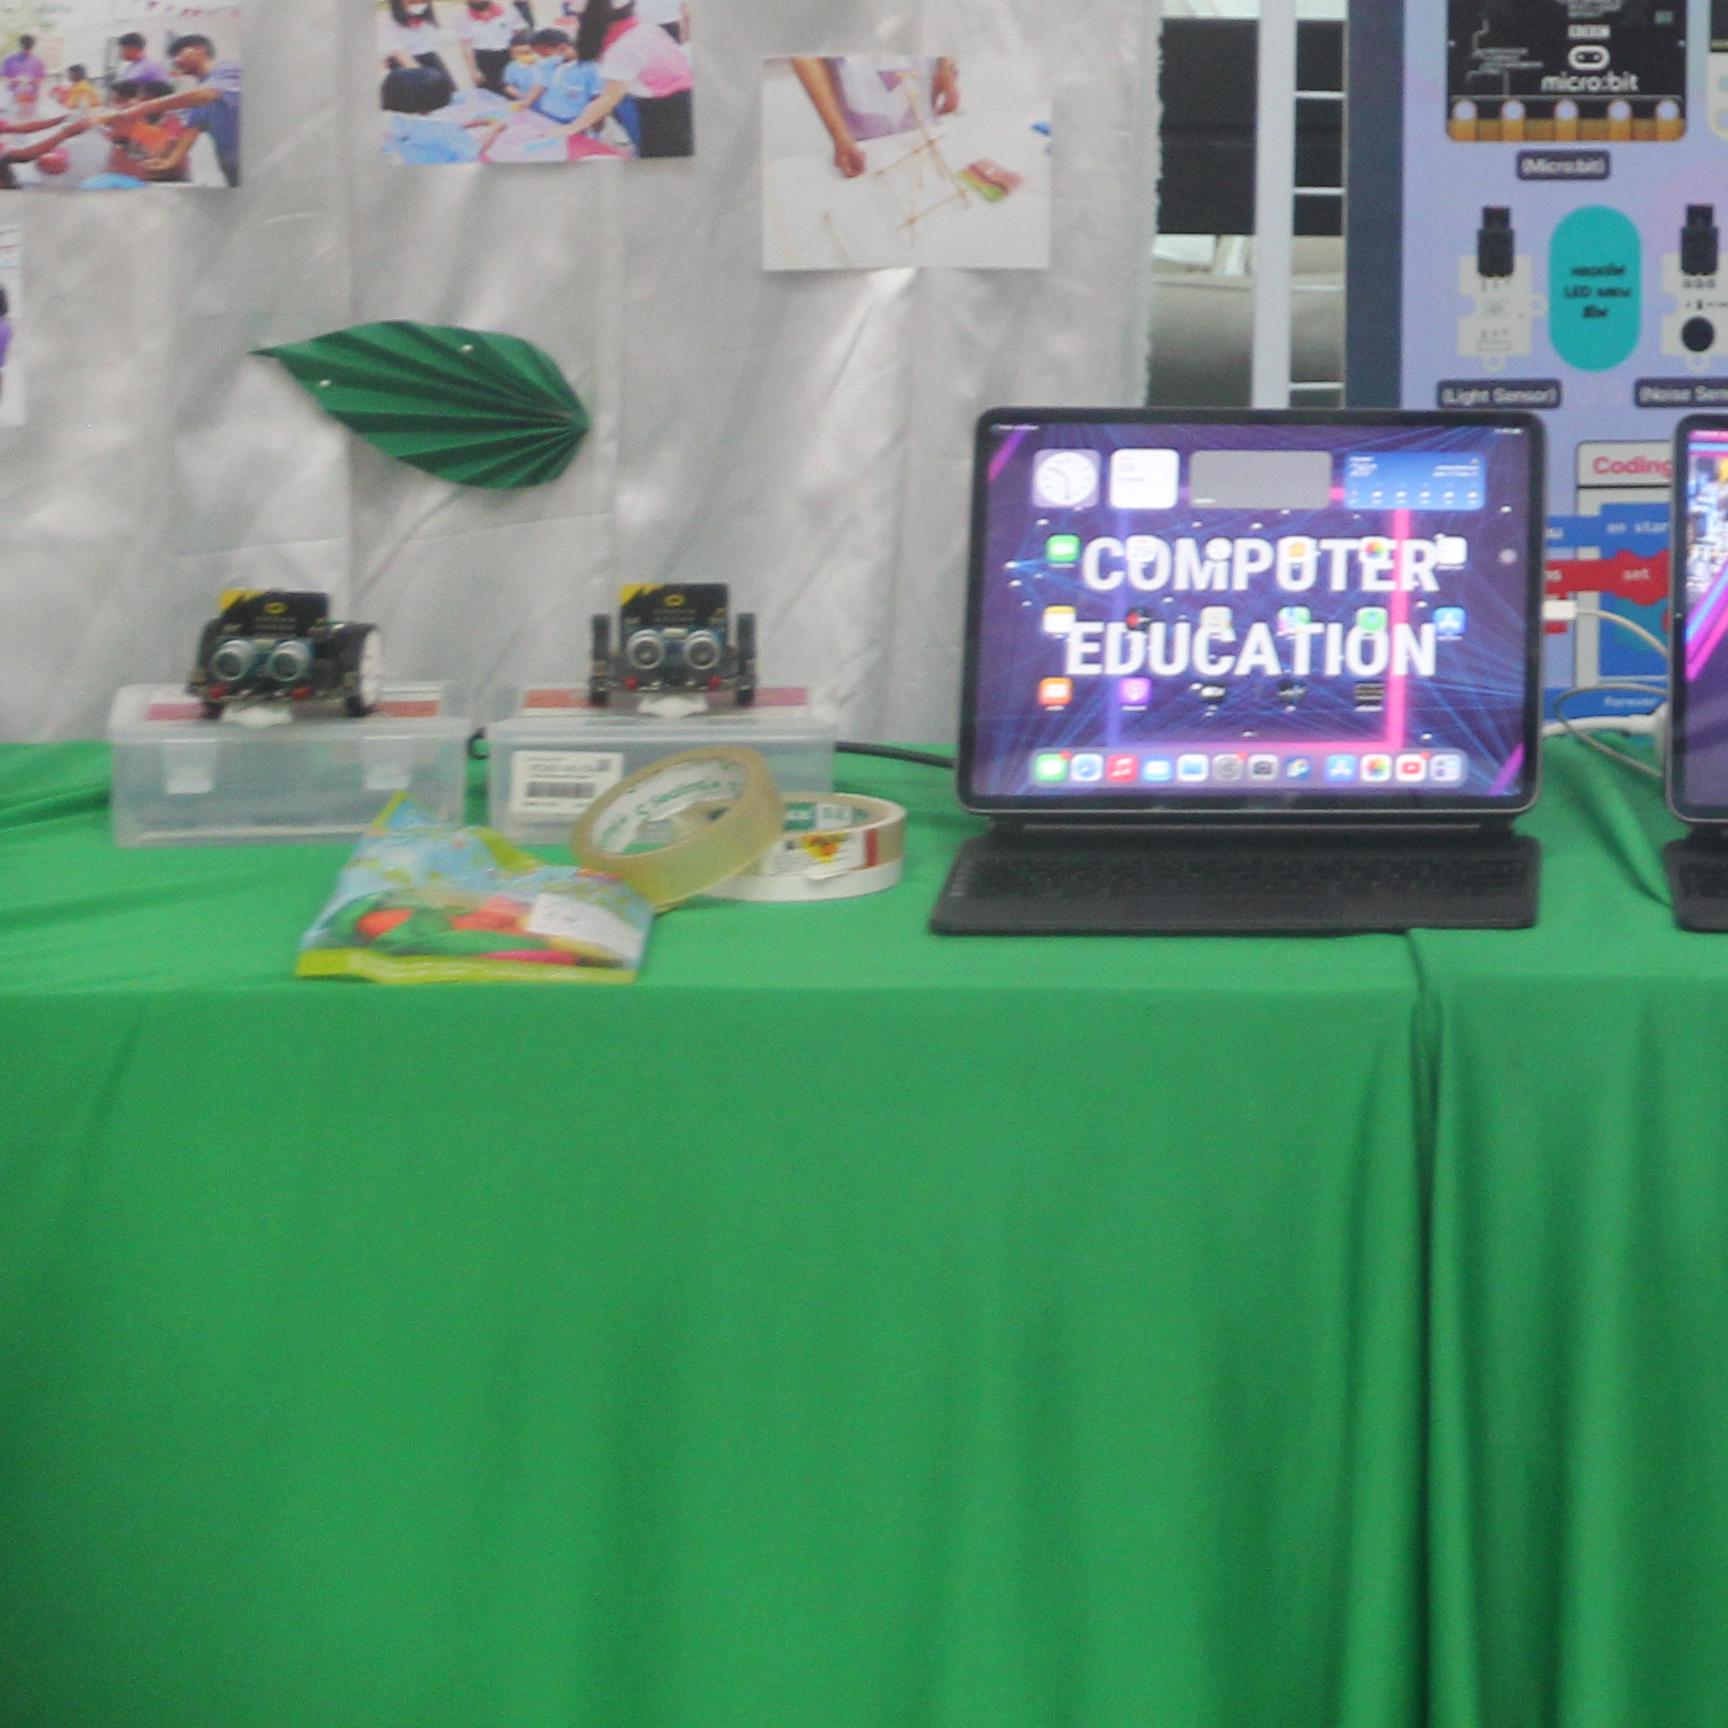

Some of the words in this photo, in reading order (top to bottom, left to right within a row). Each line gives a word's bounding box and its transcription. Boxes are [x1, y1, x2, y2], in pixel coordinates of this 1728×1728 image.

[1540, 71, 1640, 93] micro:bit
[1082, 536, 1440, 592] COMPUTER
[1064, 620, 1437, 677] EDUCATION
